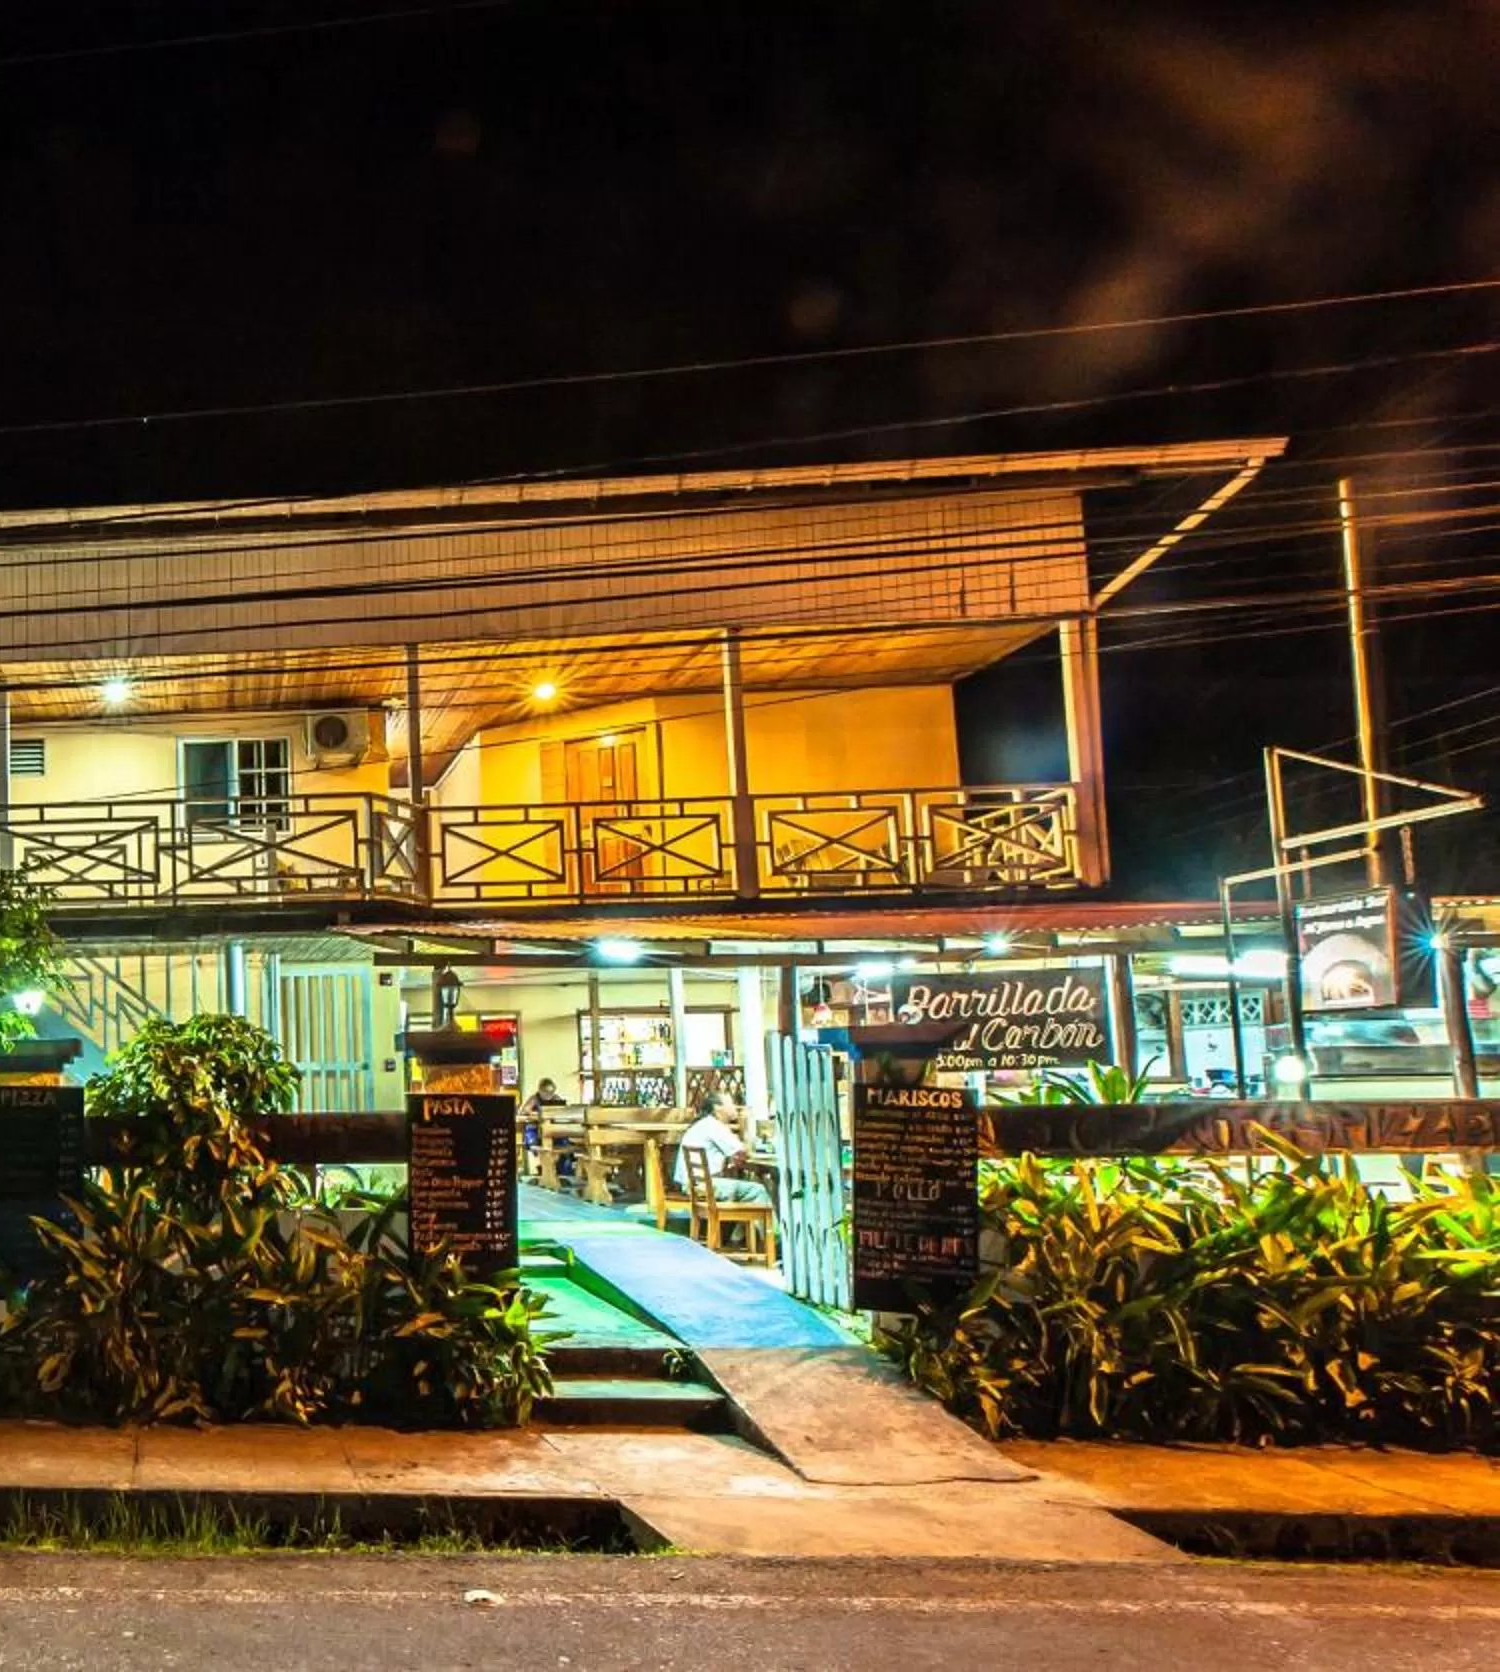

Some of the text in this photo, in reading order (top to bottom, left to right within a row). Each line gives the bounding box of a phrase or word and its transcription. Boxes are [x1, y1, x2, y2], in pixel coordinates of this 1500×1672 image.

[907, 975, 1098, 1021] Parrillada
[0, 1087, 57, 1106] PIZZA
[866, 1087, 964, 1110] MARISCOS
[423, 1097, 476, 1121] PASTA
